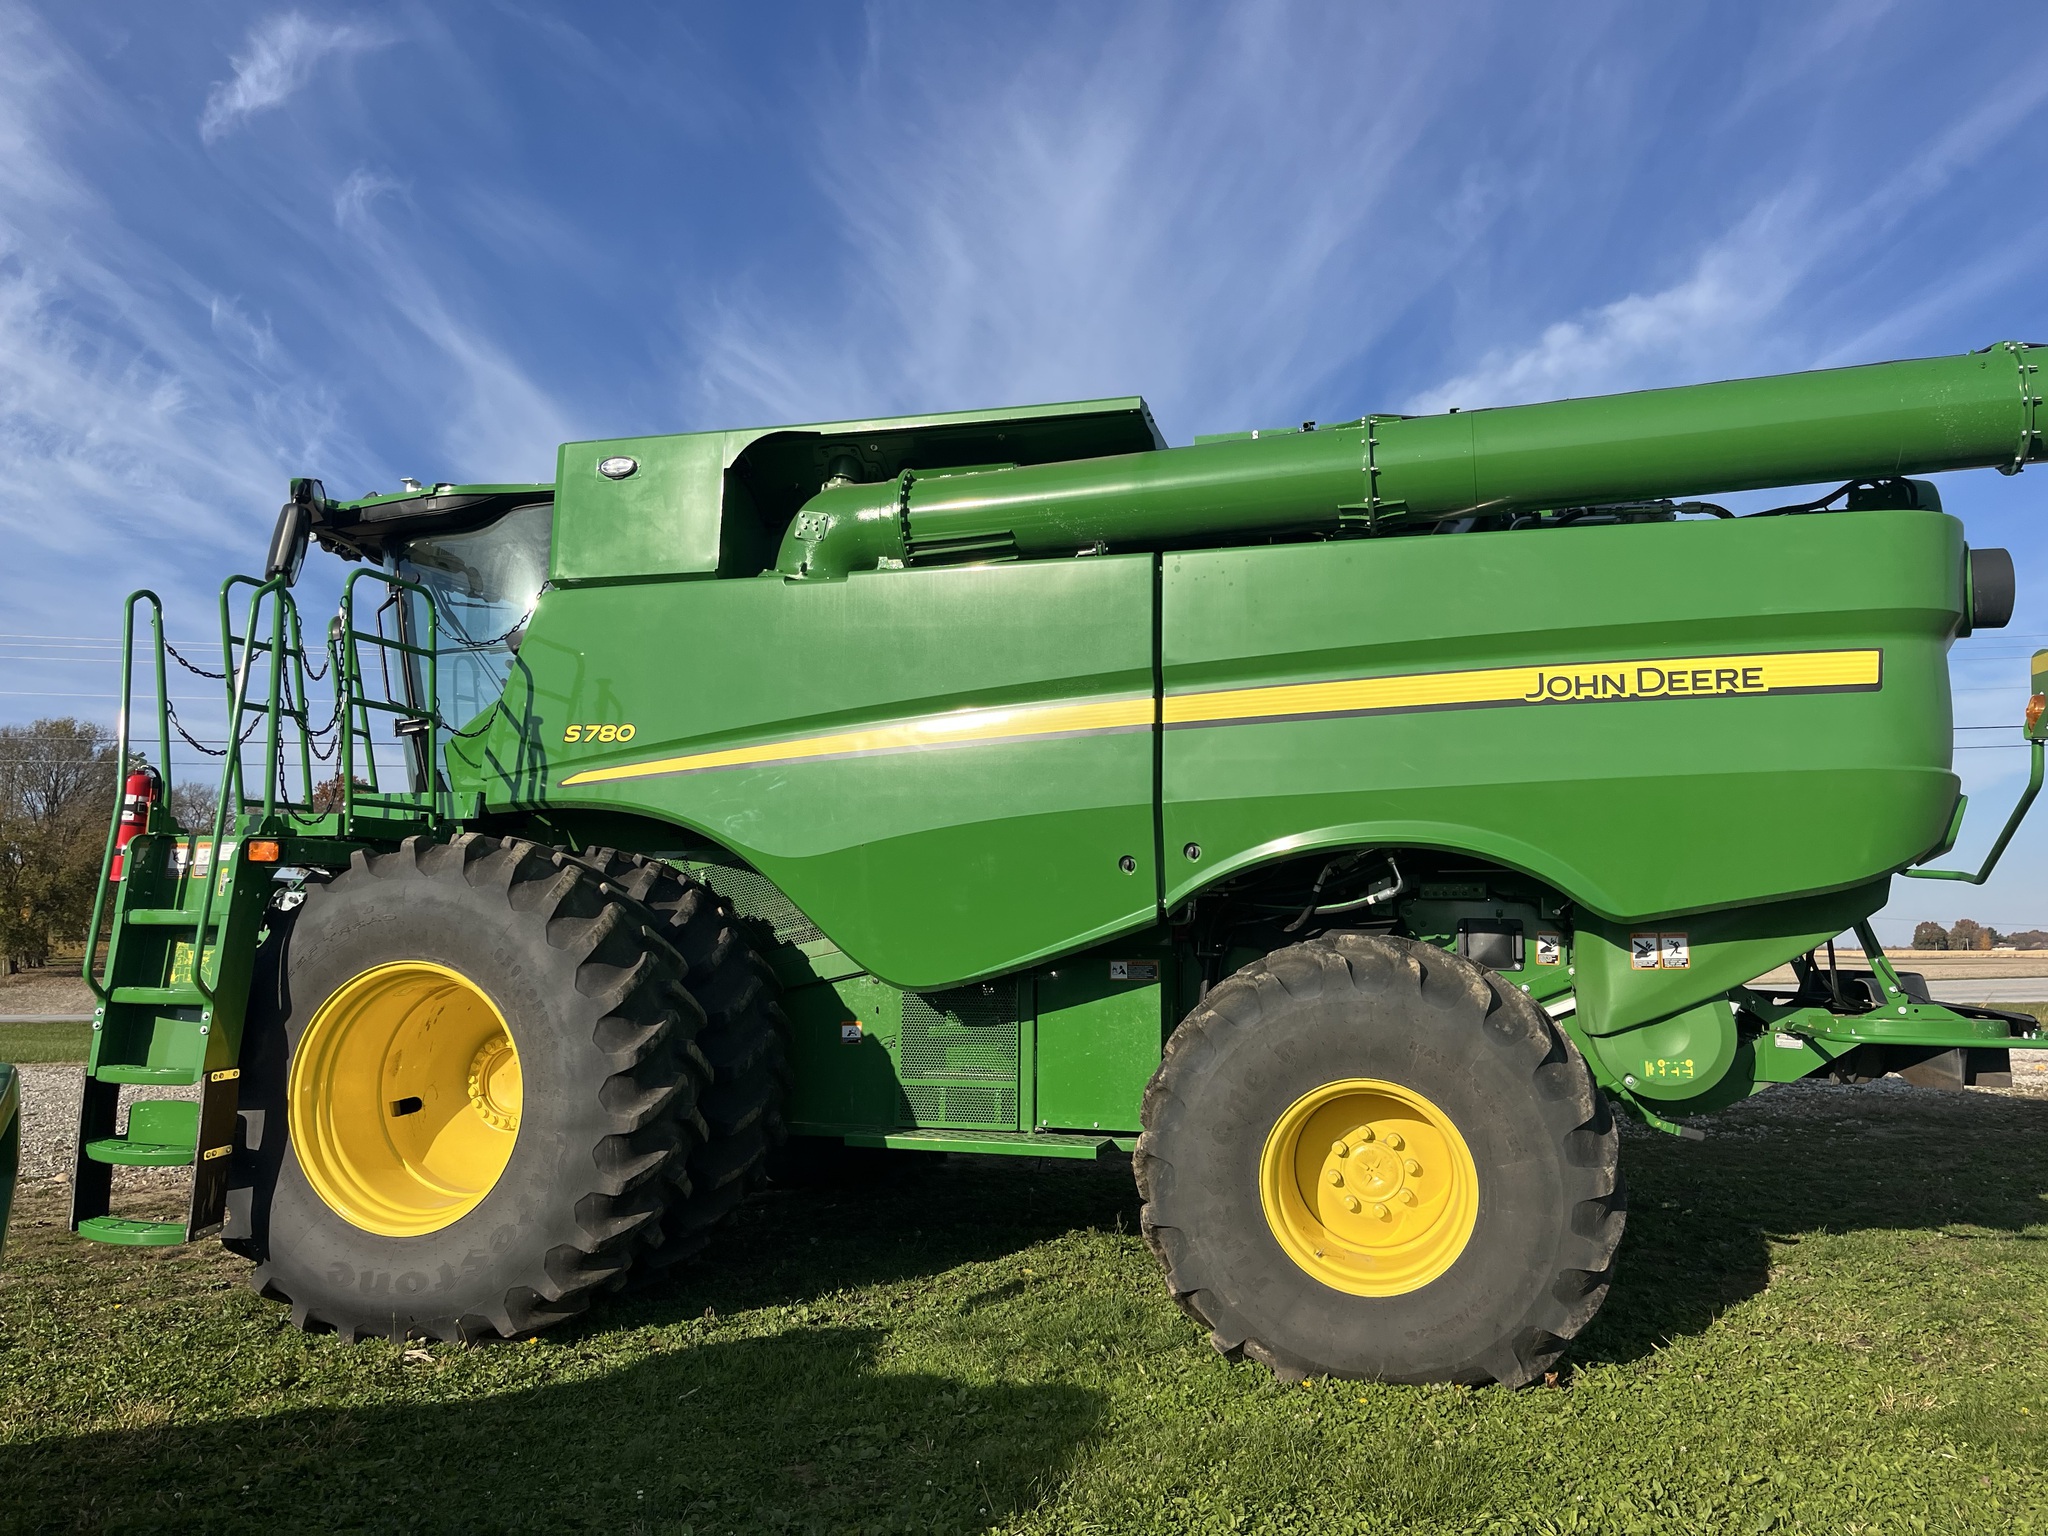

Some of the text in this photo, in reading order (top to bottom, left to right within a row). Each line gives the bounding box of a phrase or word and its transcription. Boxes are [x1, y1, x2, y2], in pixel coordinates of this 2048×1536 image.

[1525, 666, 1765, 699] JOHN DEERE
[563, 723, 636, 743] S780
